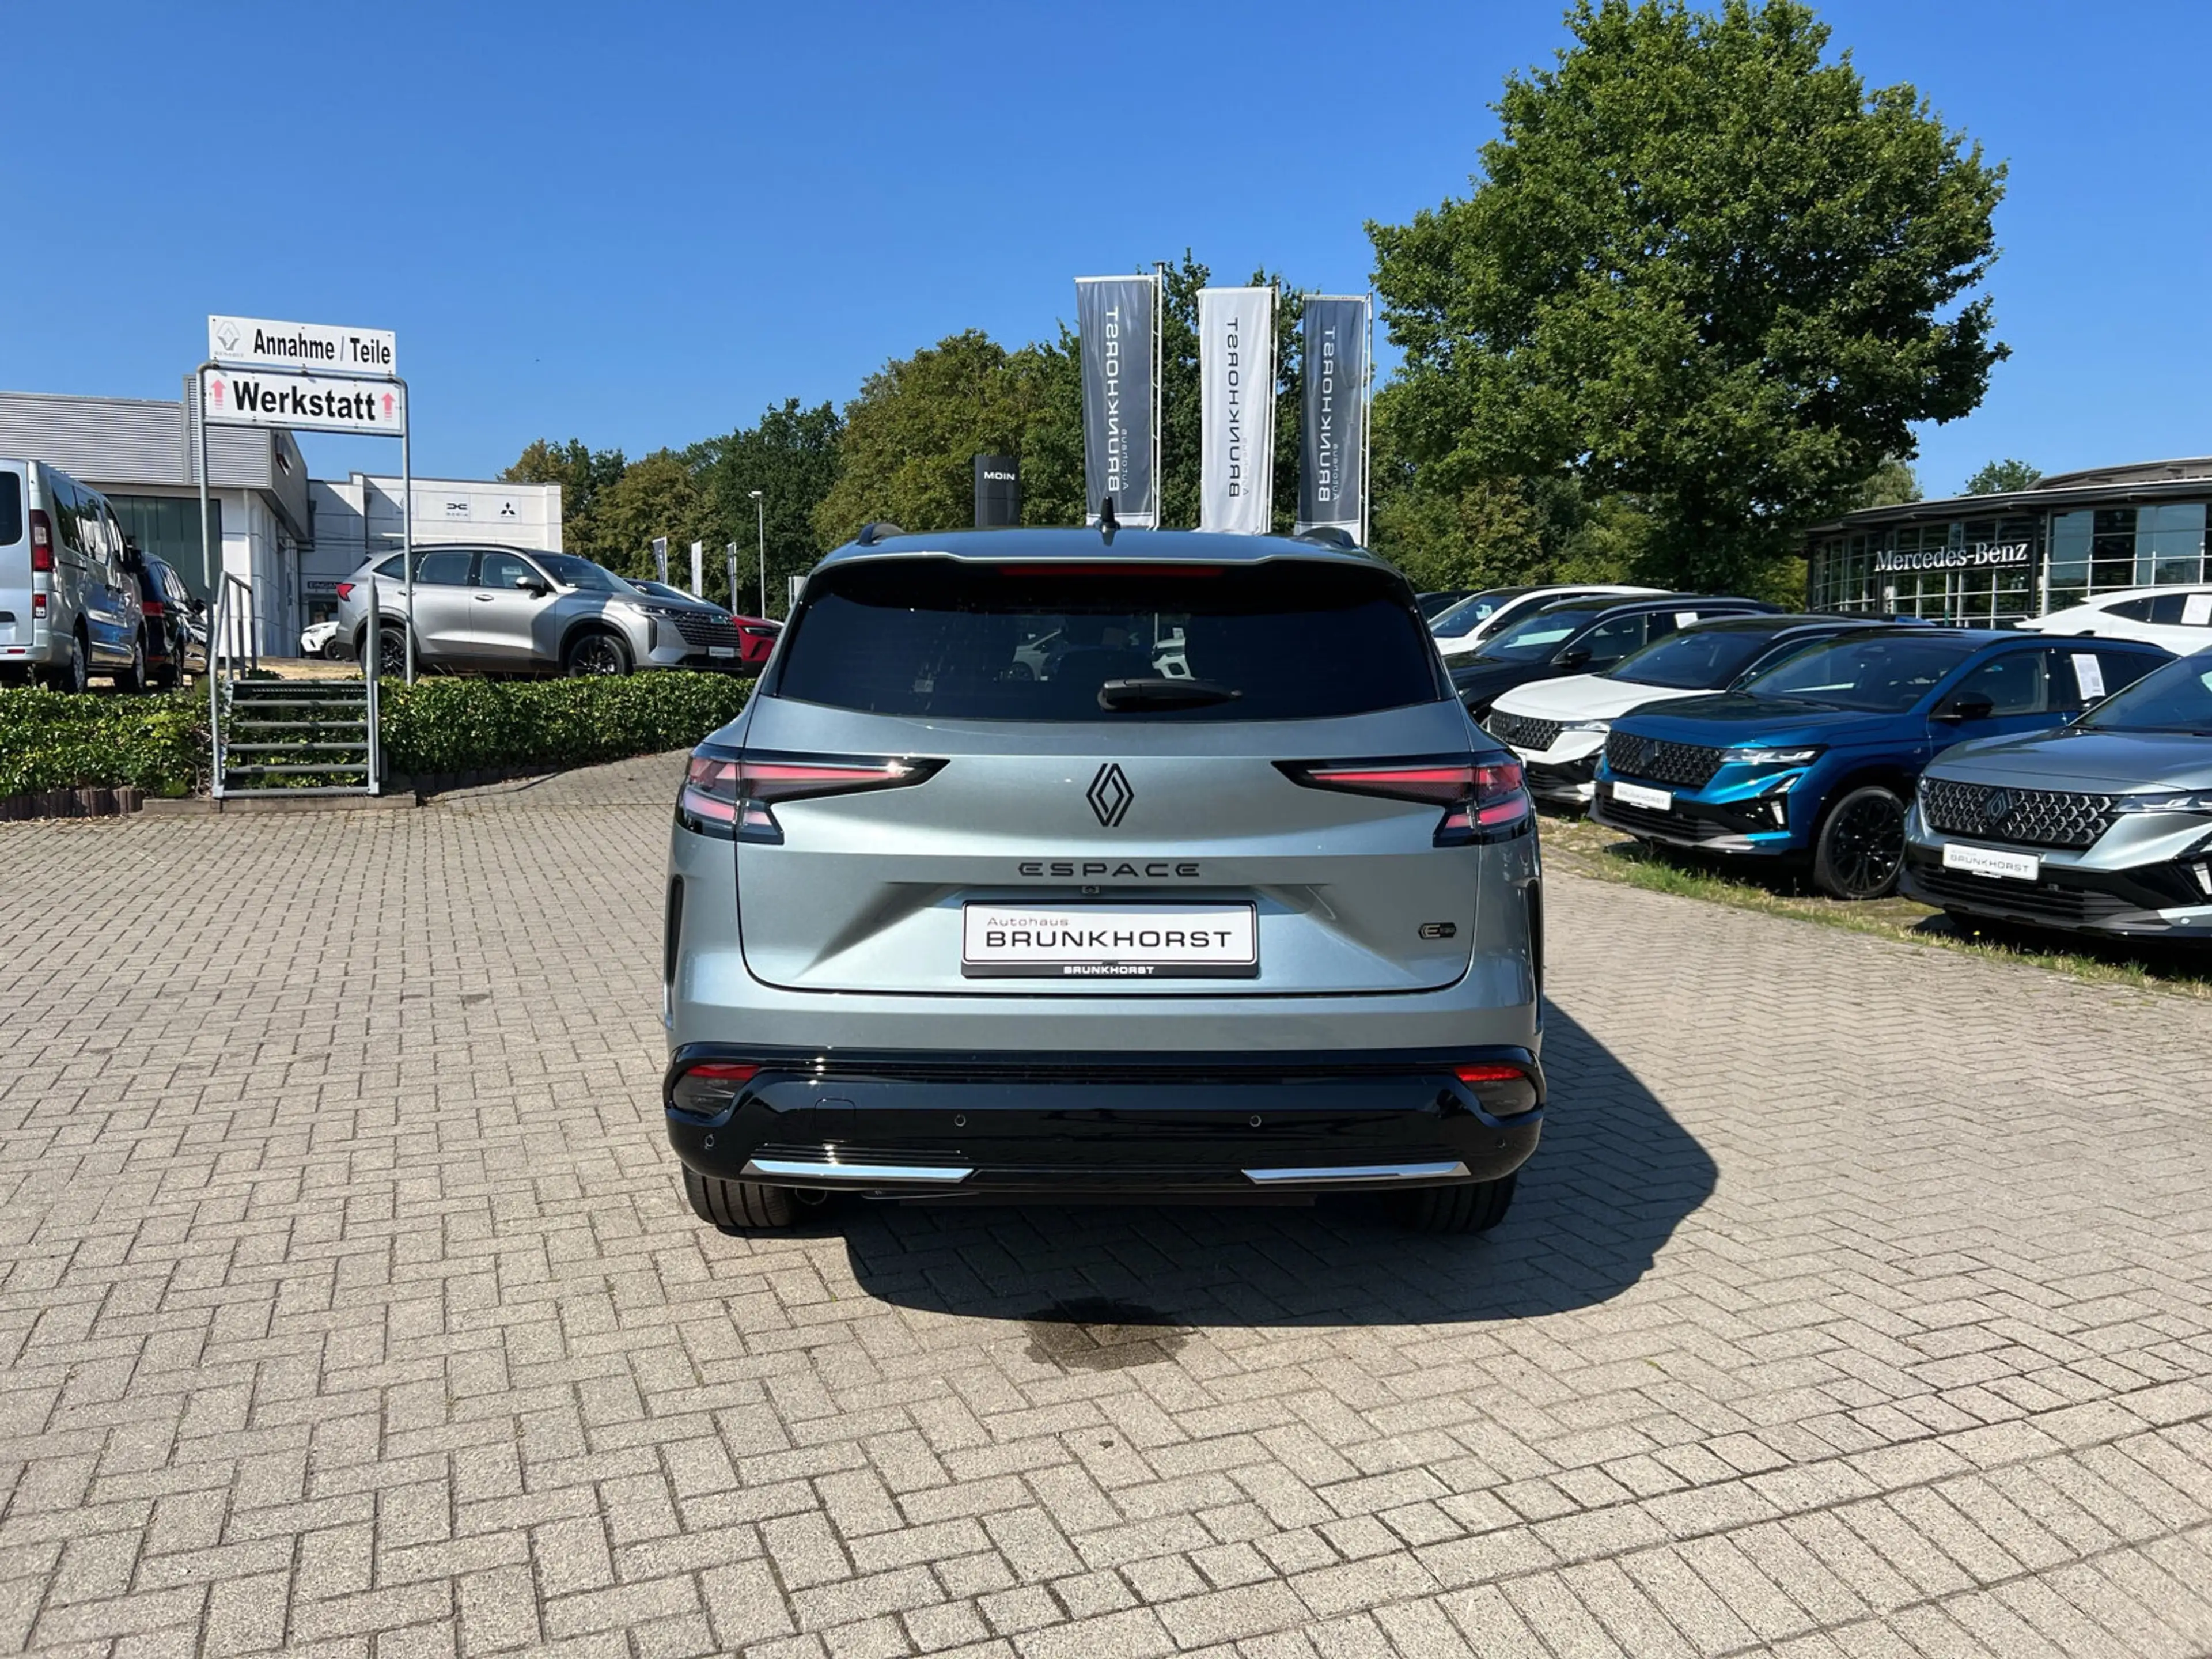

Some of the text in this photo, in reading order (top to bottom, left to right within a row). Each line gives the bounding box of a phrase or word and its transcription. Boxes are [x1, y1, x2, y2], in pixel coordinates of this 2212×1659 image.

[253, 328, 335, 360] Annahme
[350, 338, 391, 364] Teile
[233, 380, 376, 421] Werkstatt
[984, 471, 1016, 480] MOIN
[1874, 541, 2028, 572] Mercedes-Benz
[1018, 862, 1200, 877] ESPACE
[1950, 854, 2029, 872] BRUNKHORST
[987, 917, 1069, 926] Autohaus
[986, 931, 1232, 948] BRUNKHORST
[1063, 965, 1154, 975] BRUNKHORST
